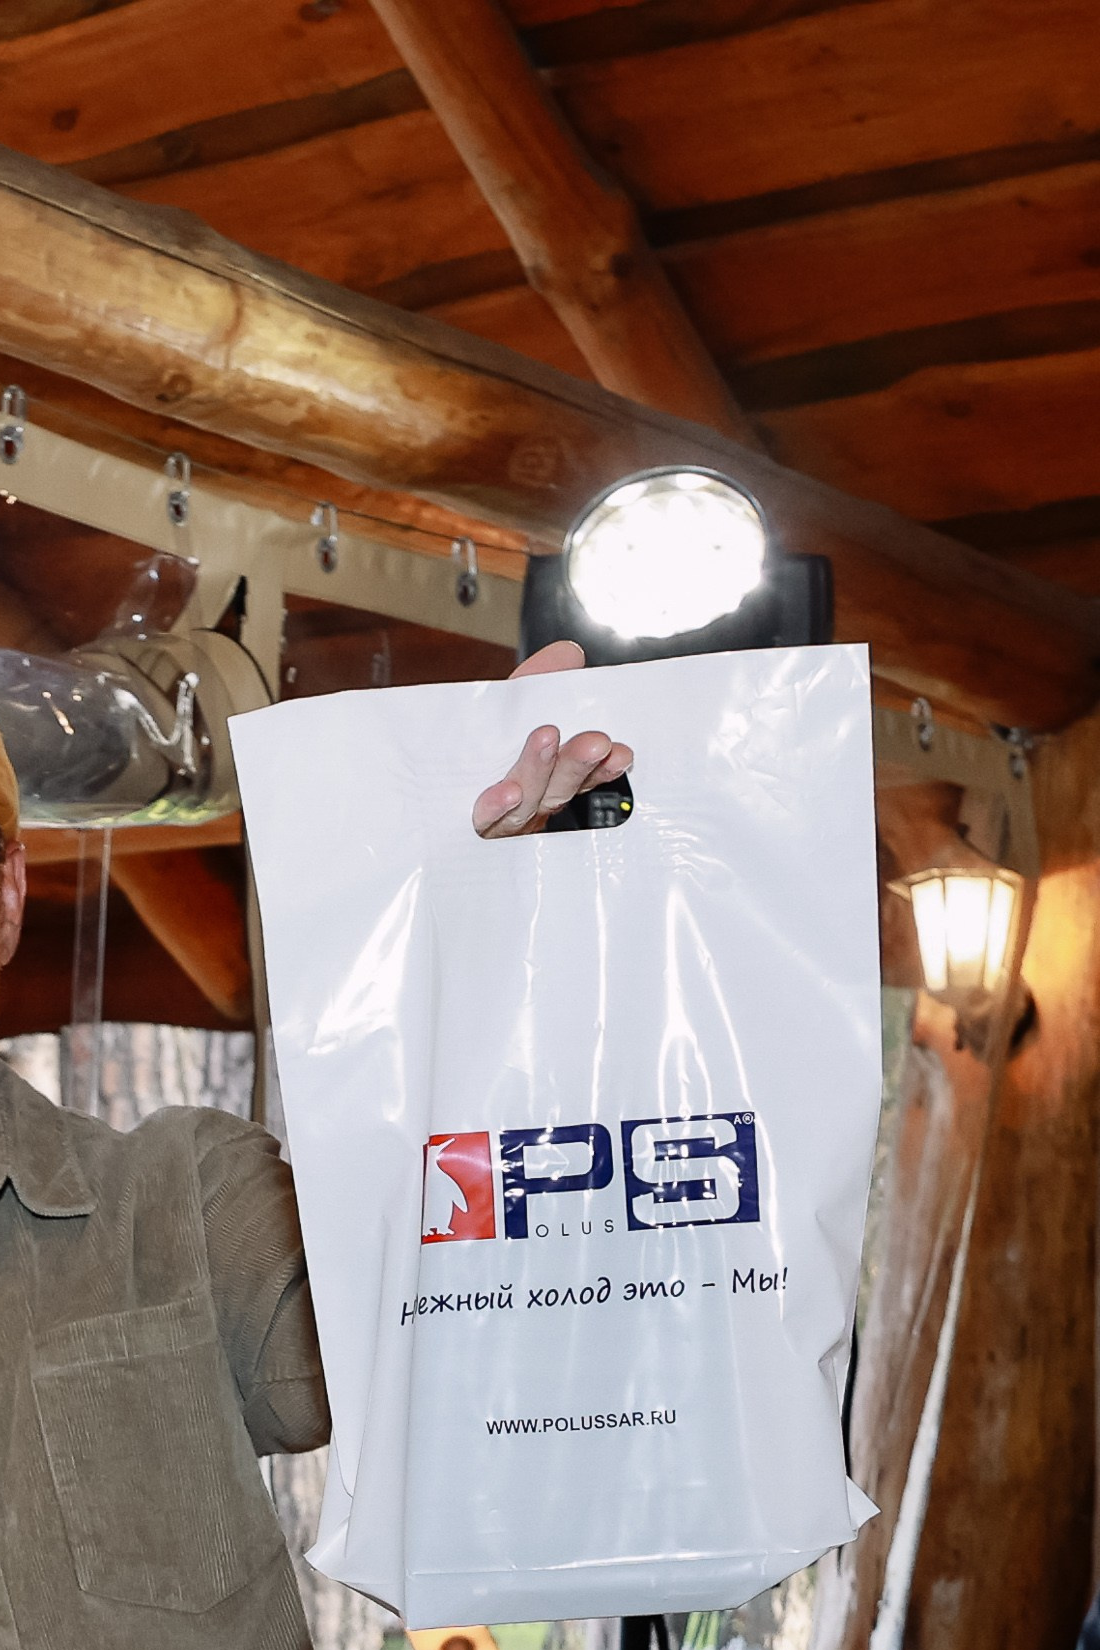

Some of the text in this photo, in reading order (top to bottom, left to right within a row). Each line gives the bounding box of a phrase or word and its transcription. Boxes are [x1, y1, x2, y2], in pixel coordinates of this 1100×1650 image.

[526, 1276, 612, 1310] холод
[622, 1277, 686, 1301] это
[731, 1266, 789, 1296] Мы!
[485, 1409, 678, 1437] WWW.POLUSSAR.RU
